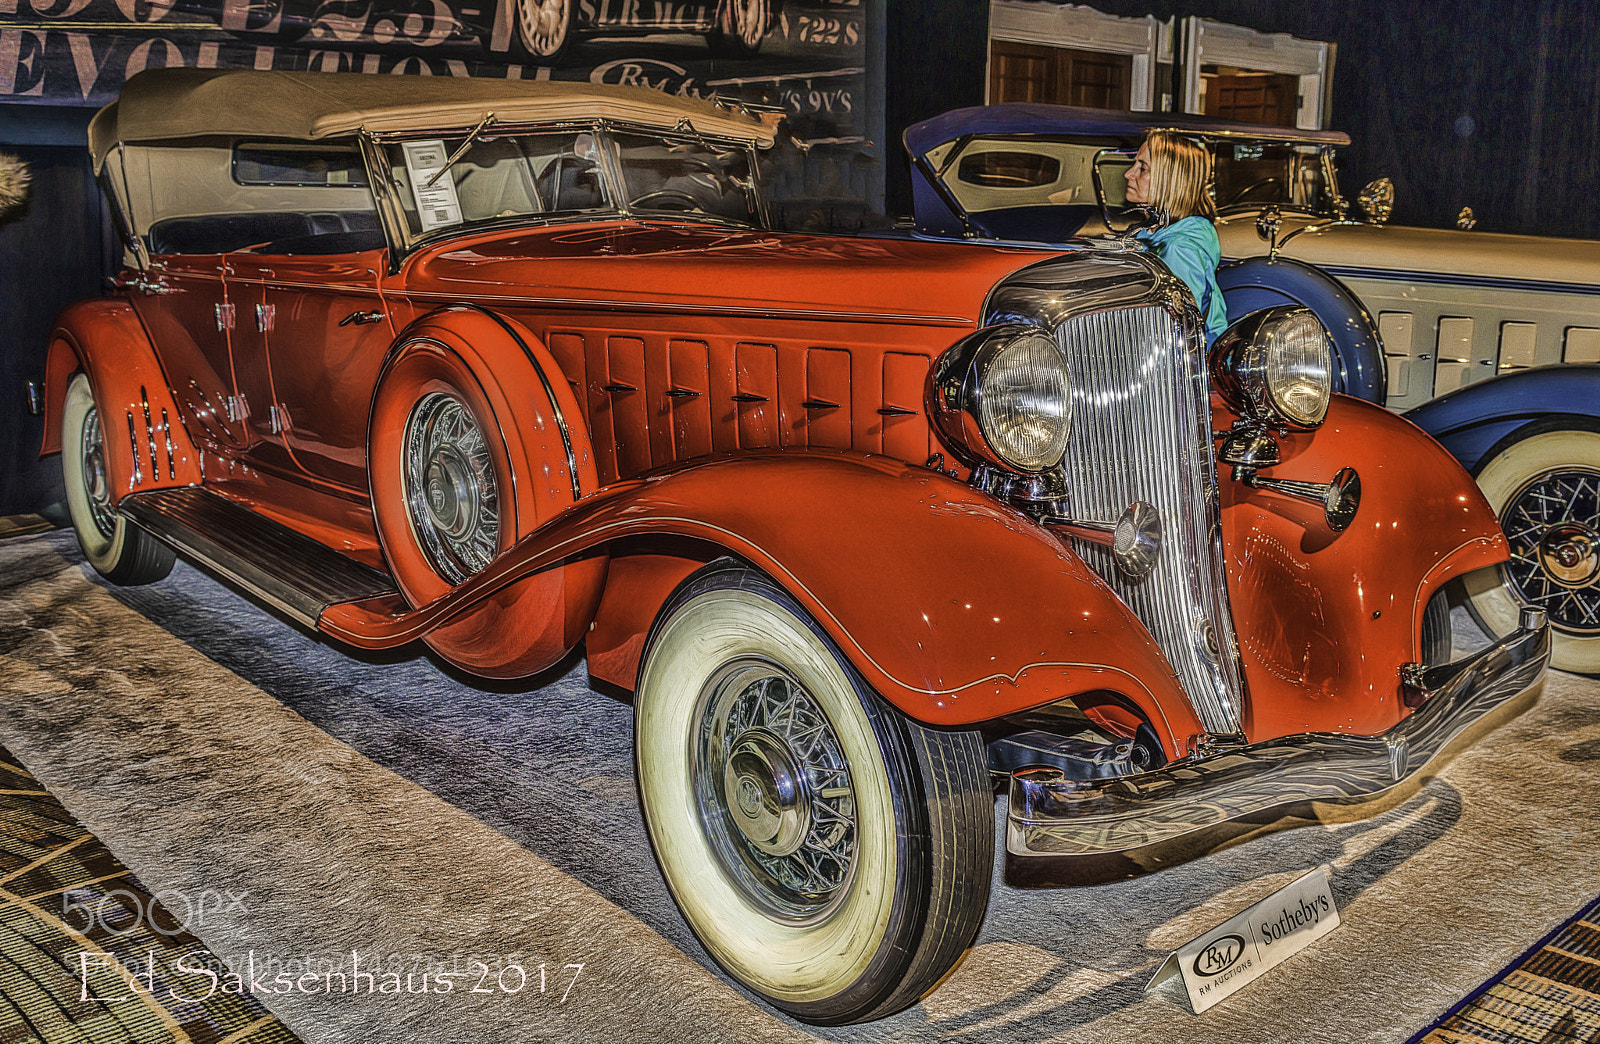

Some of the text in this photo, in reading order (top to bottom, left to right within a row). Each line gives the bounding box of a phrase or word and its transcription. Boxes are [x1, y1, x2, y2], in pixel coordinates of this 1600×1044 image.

[799, 16, 840, 44] 722
[1261, 895, 1330, 947] Sotheby's
[1206, 945, 1233, 970] RM
[1199, 960, 1253, 996] RM AUCTIONS
